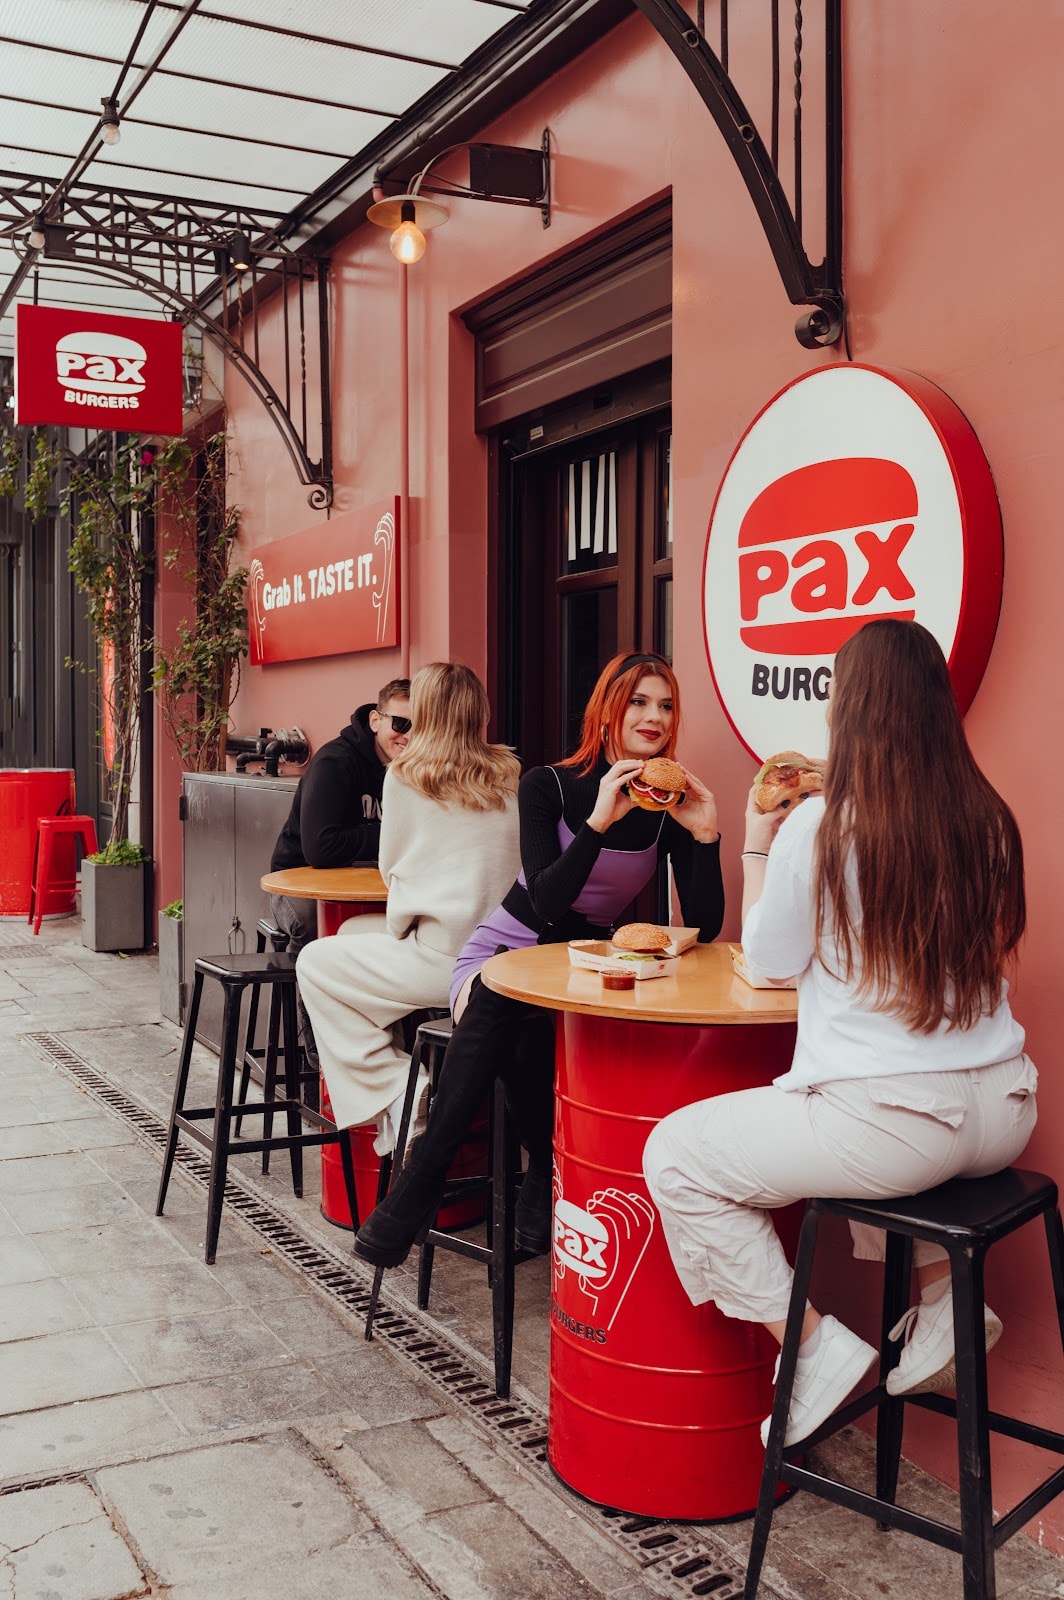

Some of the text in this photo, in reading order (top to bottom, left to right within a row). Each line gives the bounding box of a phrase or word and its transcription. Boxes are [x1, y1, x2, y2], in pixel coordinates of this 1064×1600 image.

[64, 390, 139, 409] BURGERS
[262, 577, 291, 611] Grab
[308, 558, 354, 600] TASTE
[357, 552, 377, 589] IT.
[752, 663, 832, 702] BURG
